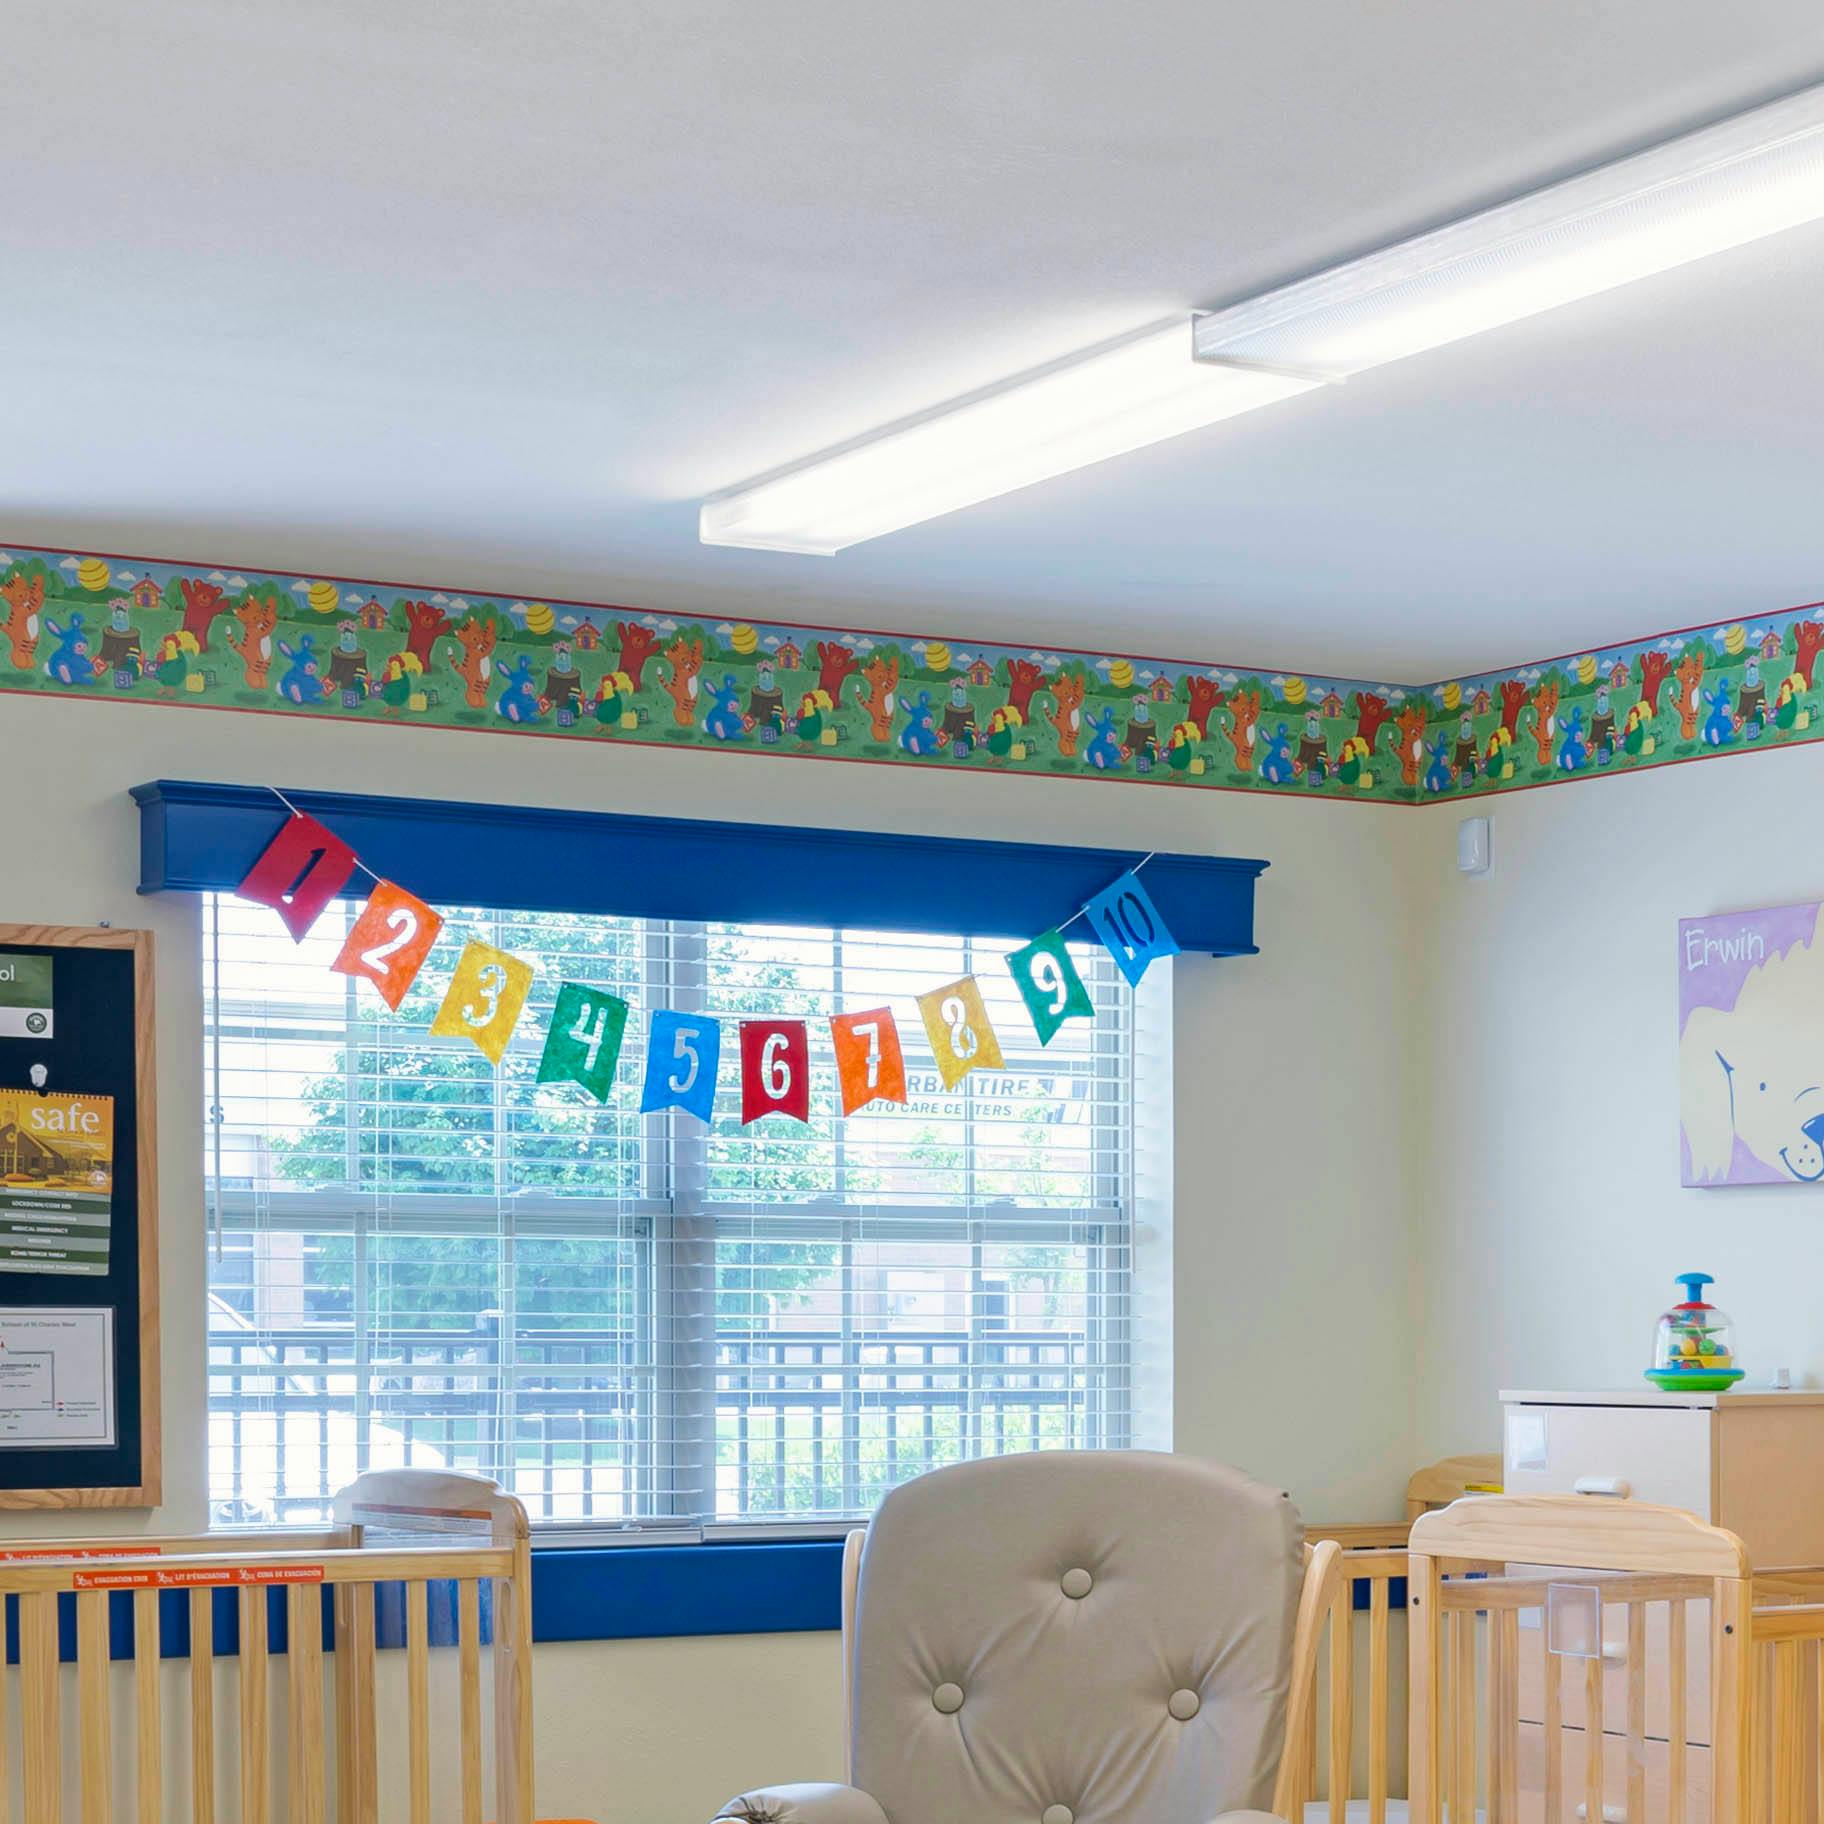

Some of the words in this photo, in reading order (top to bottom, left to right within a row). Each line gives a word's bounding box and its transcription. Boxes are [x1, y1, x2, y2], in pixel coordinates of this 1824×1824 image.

[1683, 923, 1766, 972] Erwin
[282, 846, 327, 903] 1
[363, 909, 419, 976] 2
[462, 962, 507, 1028] 3
[569, 1000, 619, 1073] 4
[669, 1027, 701, 1094] 5
[762, 1033, 790, 1100] 6
[855, 1022, 887, 1088] 7
[938, 998, 978, 1060] 8
[1030, 949, 1070, 1016] 9
[1101, 892, 1156, 951] 10
[31, 1102, 100, 1134] safe
[900, 1101, 939, 1114] CARE
[944, 1103, 1012, 1116] CETERS
